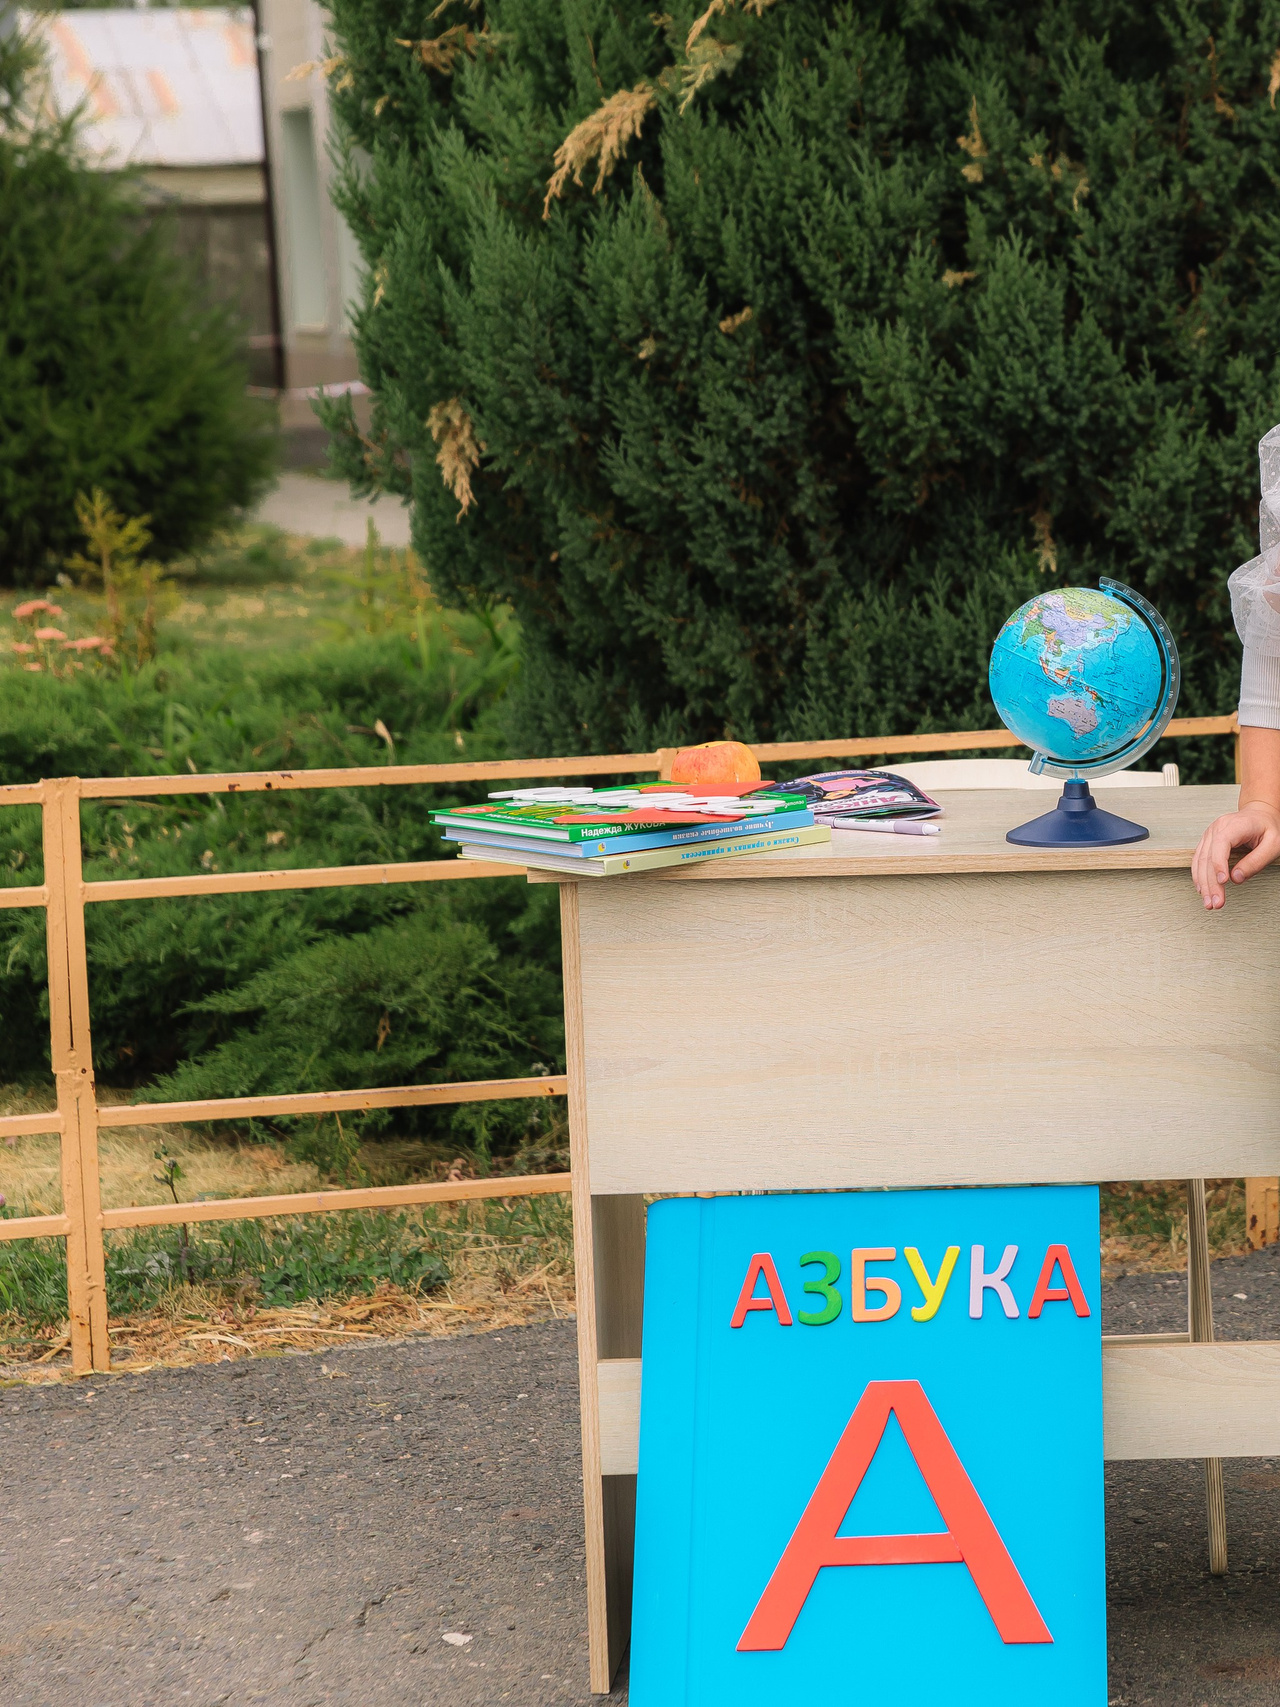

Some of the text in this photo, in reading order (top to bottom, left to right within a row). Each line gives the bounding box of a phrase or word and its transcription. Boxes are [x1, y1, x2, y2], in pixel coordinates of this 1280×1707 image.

[581, 825, 622, 837] Надежда
[672, 821, 774, 840] Лучшие волшебные сказки
[733, 841, 765, 852] принцах
[773, 836, 800, 846] Сказки
[681, 847, 725, 859] принцессах
[731, 1244, 1091, 1328] АЗБУКА
[736, 1380, 1054, 1652] А
